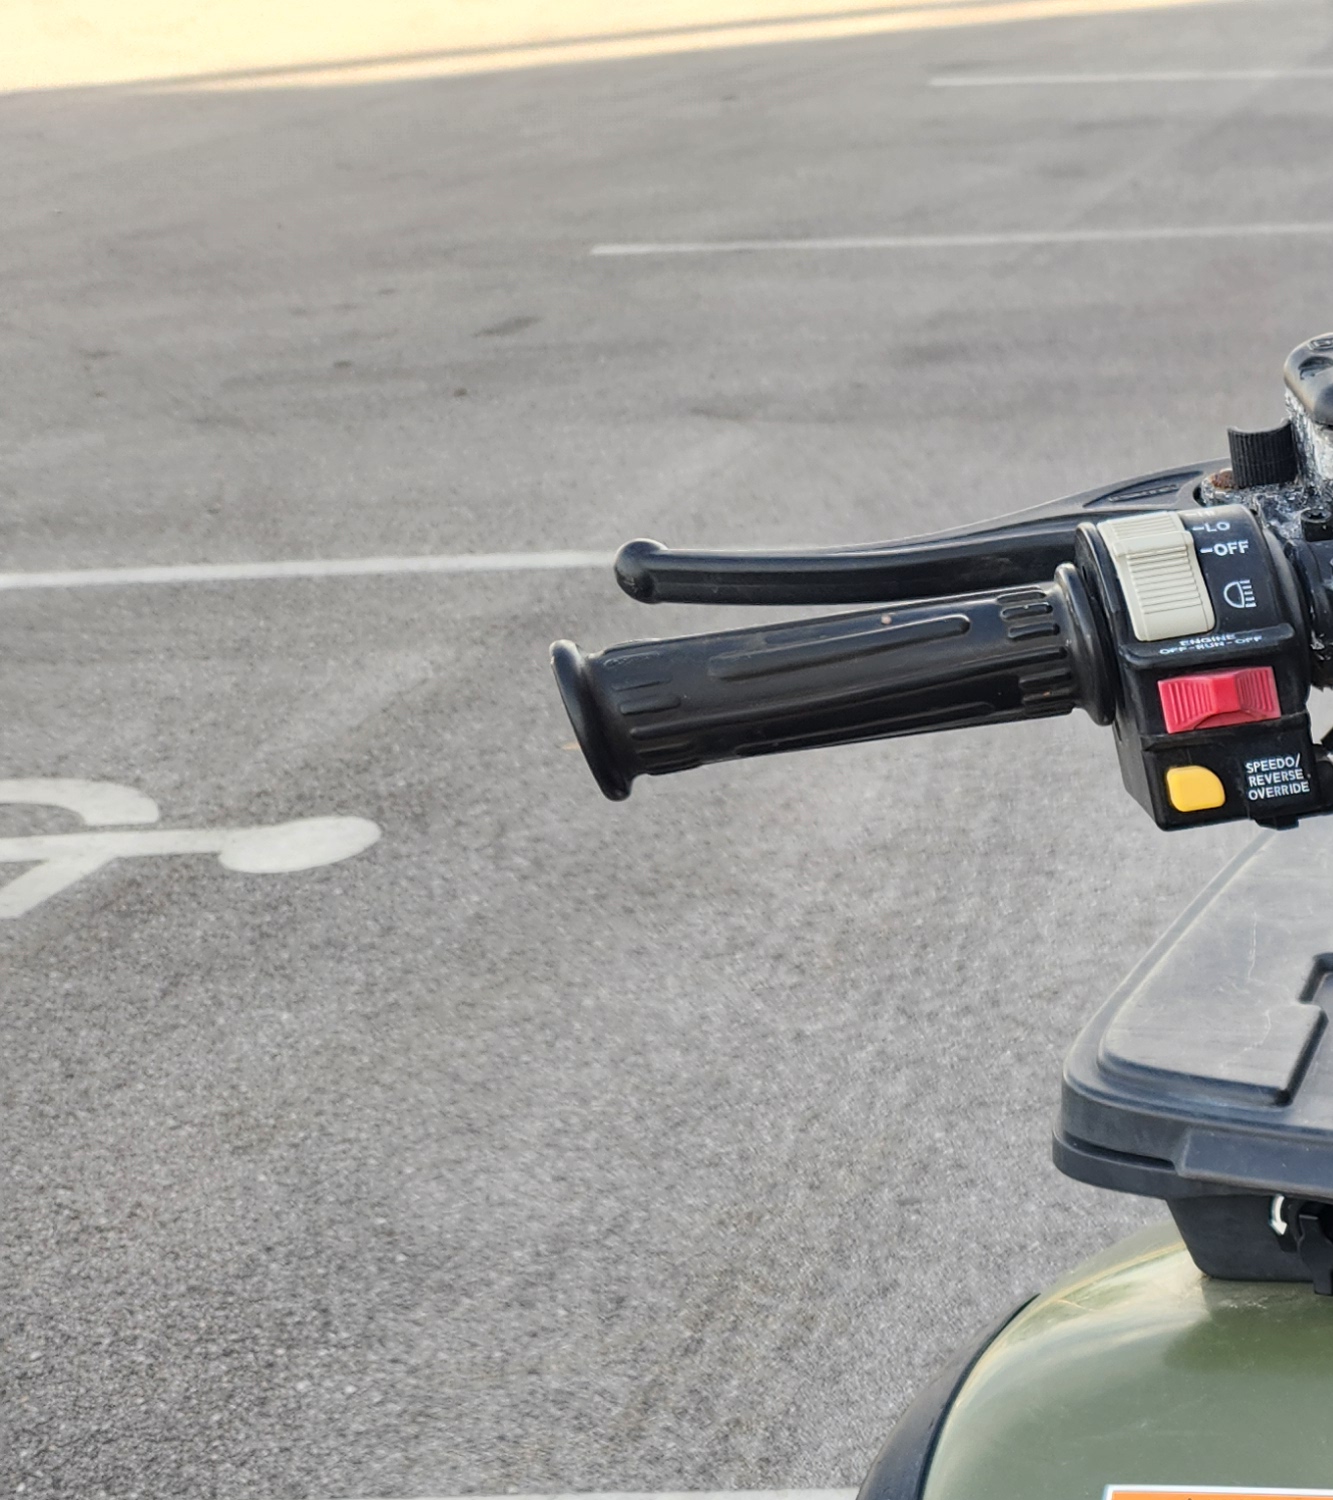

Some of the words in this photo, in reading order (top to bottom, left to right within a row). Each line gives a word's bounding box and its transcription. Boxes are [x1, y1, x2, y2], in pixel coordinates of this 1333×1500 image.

[1208, 522, 1230, 532] LO
[1214, 541, 1248, 556] OFF
[1179, 634, 1236, 646] ENGINE
[1246, 753, 1300, 773] SPEEDO/
[1248, 769, 1304, 787] REVERSE
[1248, 781, 1310, 800] OVERRIDE
